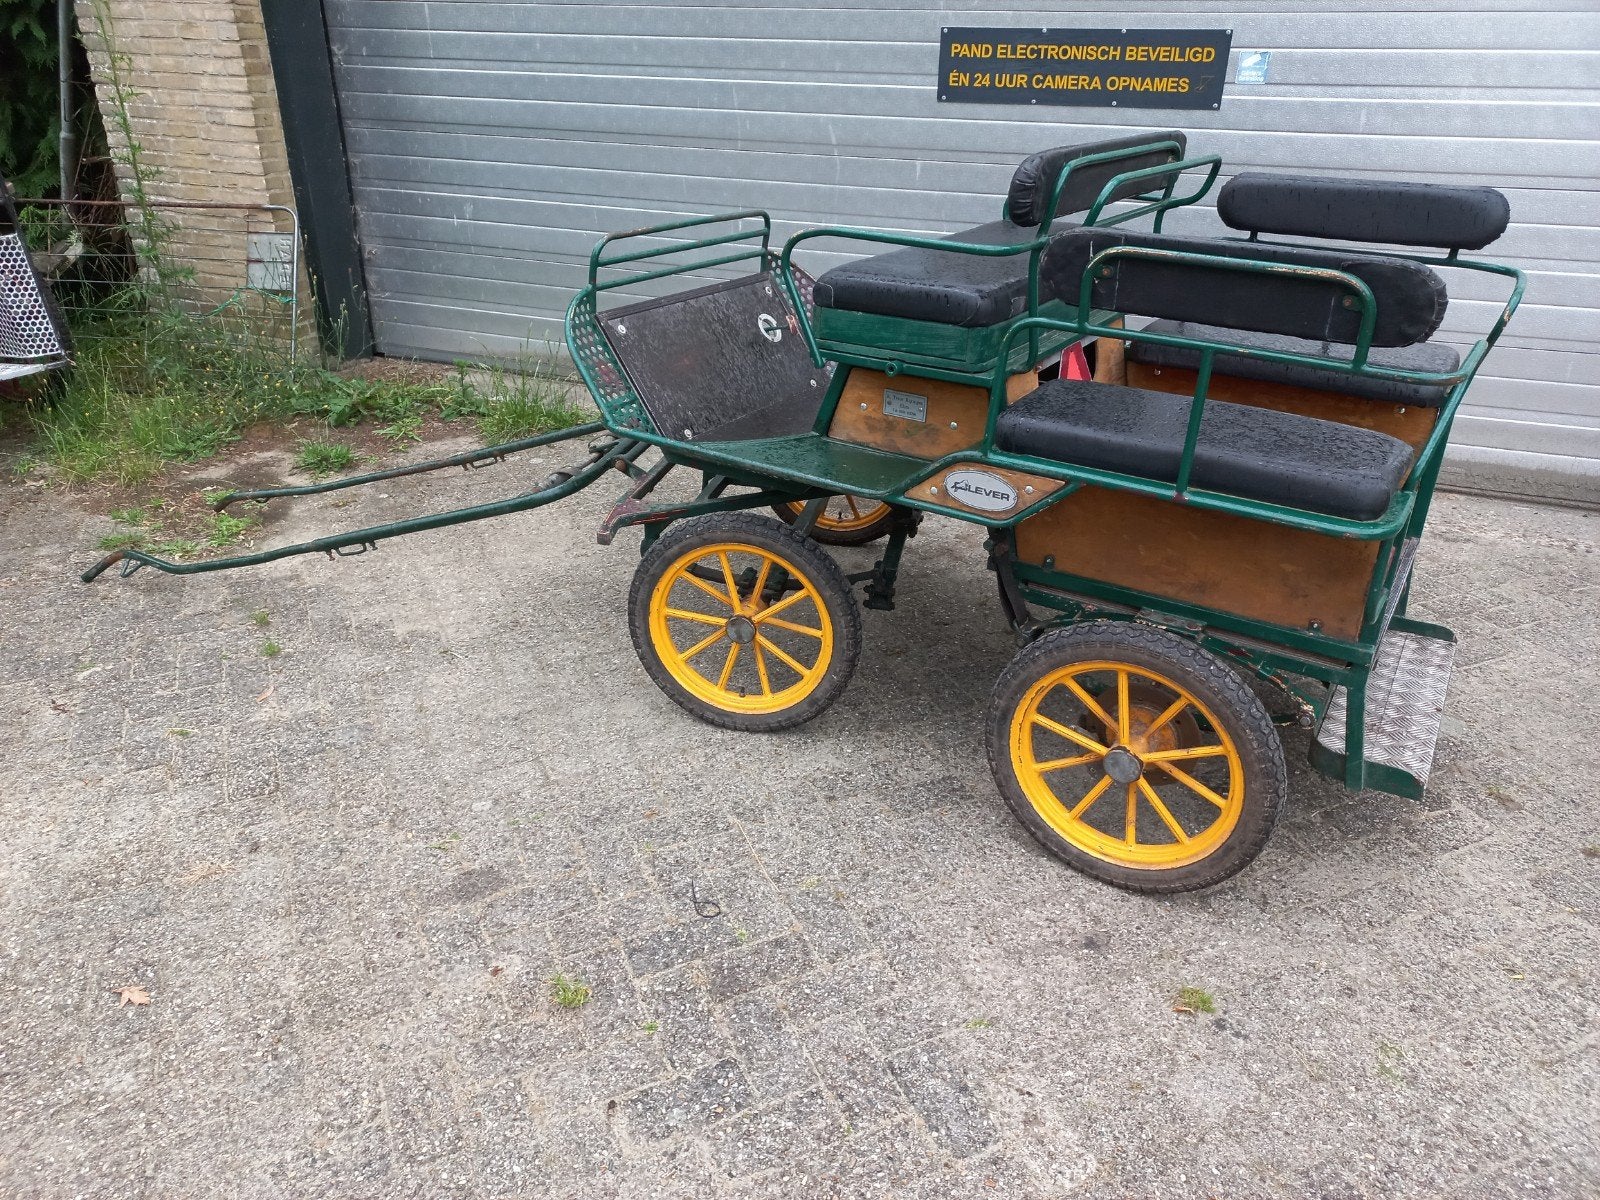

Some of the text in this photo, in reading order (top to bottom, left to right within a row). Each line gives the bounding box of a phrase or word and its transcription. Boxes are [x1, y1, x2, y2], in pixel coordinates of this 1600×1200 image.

[951, 43, 1216, 62] PAND ELECTRONISCH BEVEILIGD
[949, 69, 1190, 93] ÉN 24 UUR CAMERA OPNAMES
